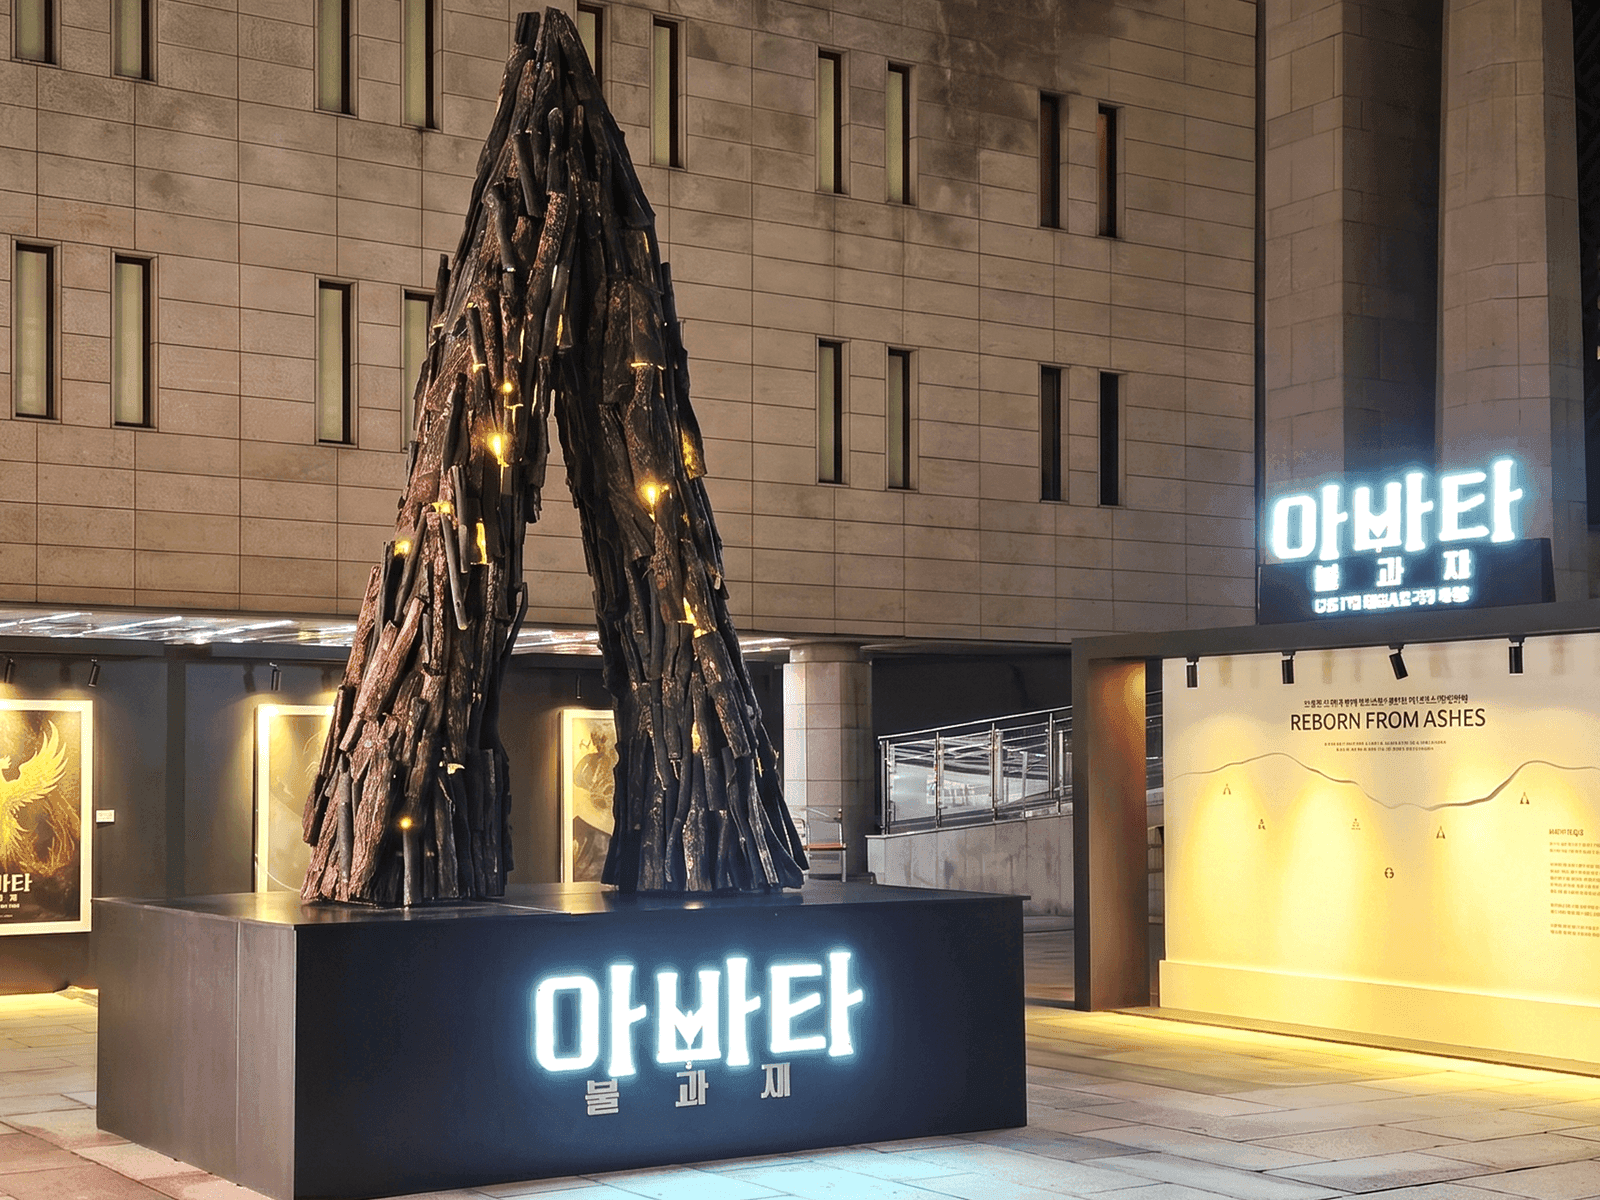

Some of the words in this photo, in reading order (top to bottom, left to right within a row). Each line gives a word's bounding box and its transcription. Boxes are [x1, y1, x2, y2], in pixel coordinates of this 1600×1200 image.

[1271, 459, 1523, 561] 아바타
[1376, 556, 1405, 587] 과
[1290, 712, 1361, 731] REBORN
[1365, 711, 1420, 730] FROM
[1423, 708, 1486, 728] ASHES
[535, 951, 864, 1077] 아바타
[585, 1079, 620, 1116] 불
[675, 1069, 709, 1107] 과
[760, 1062, 791, 1099] 재
